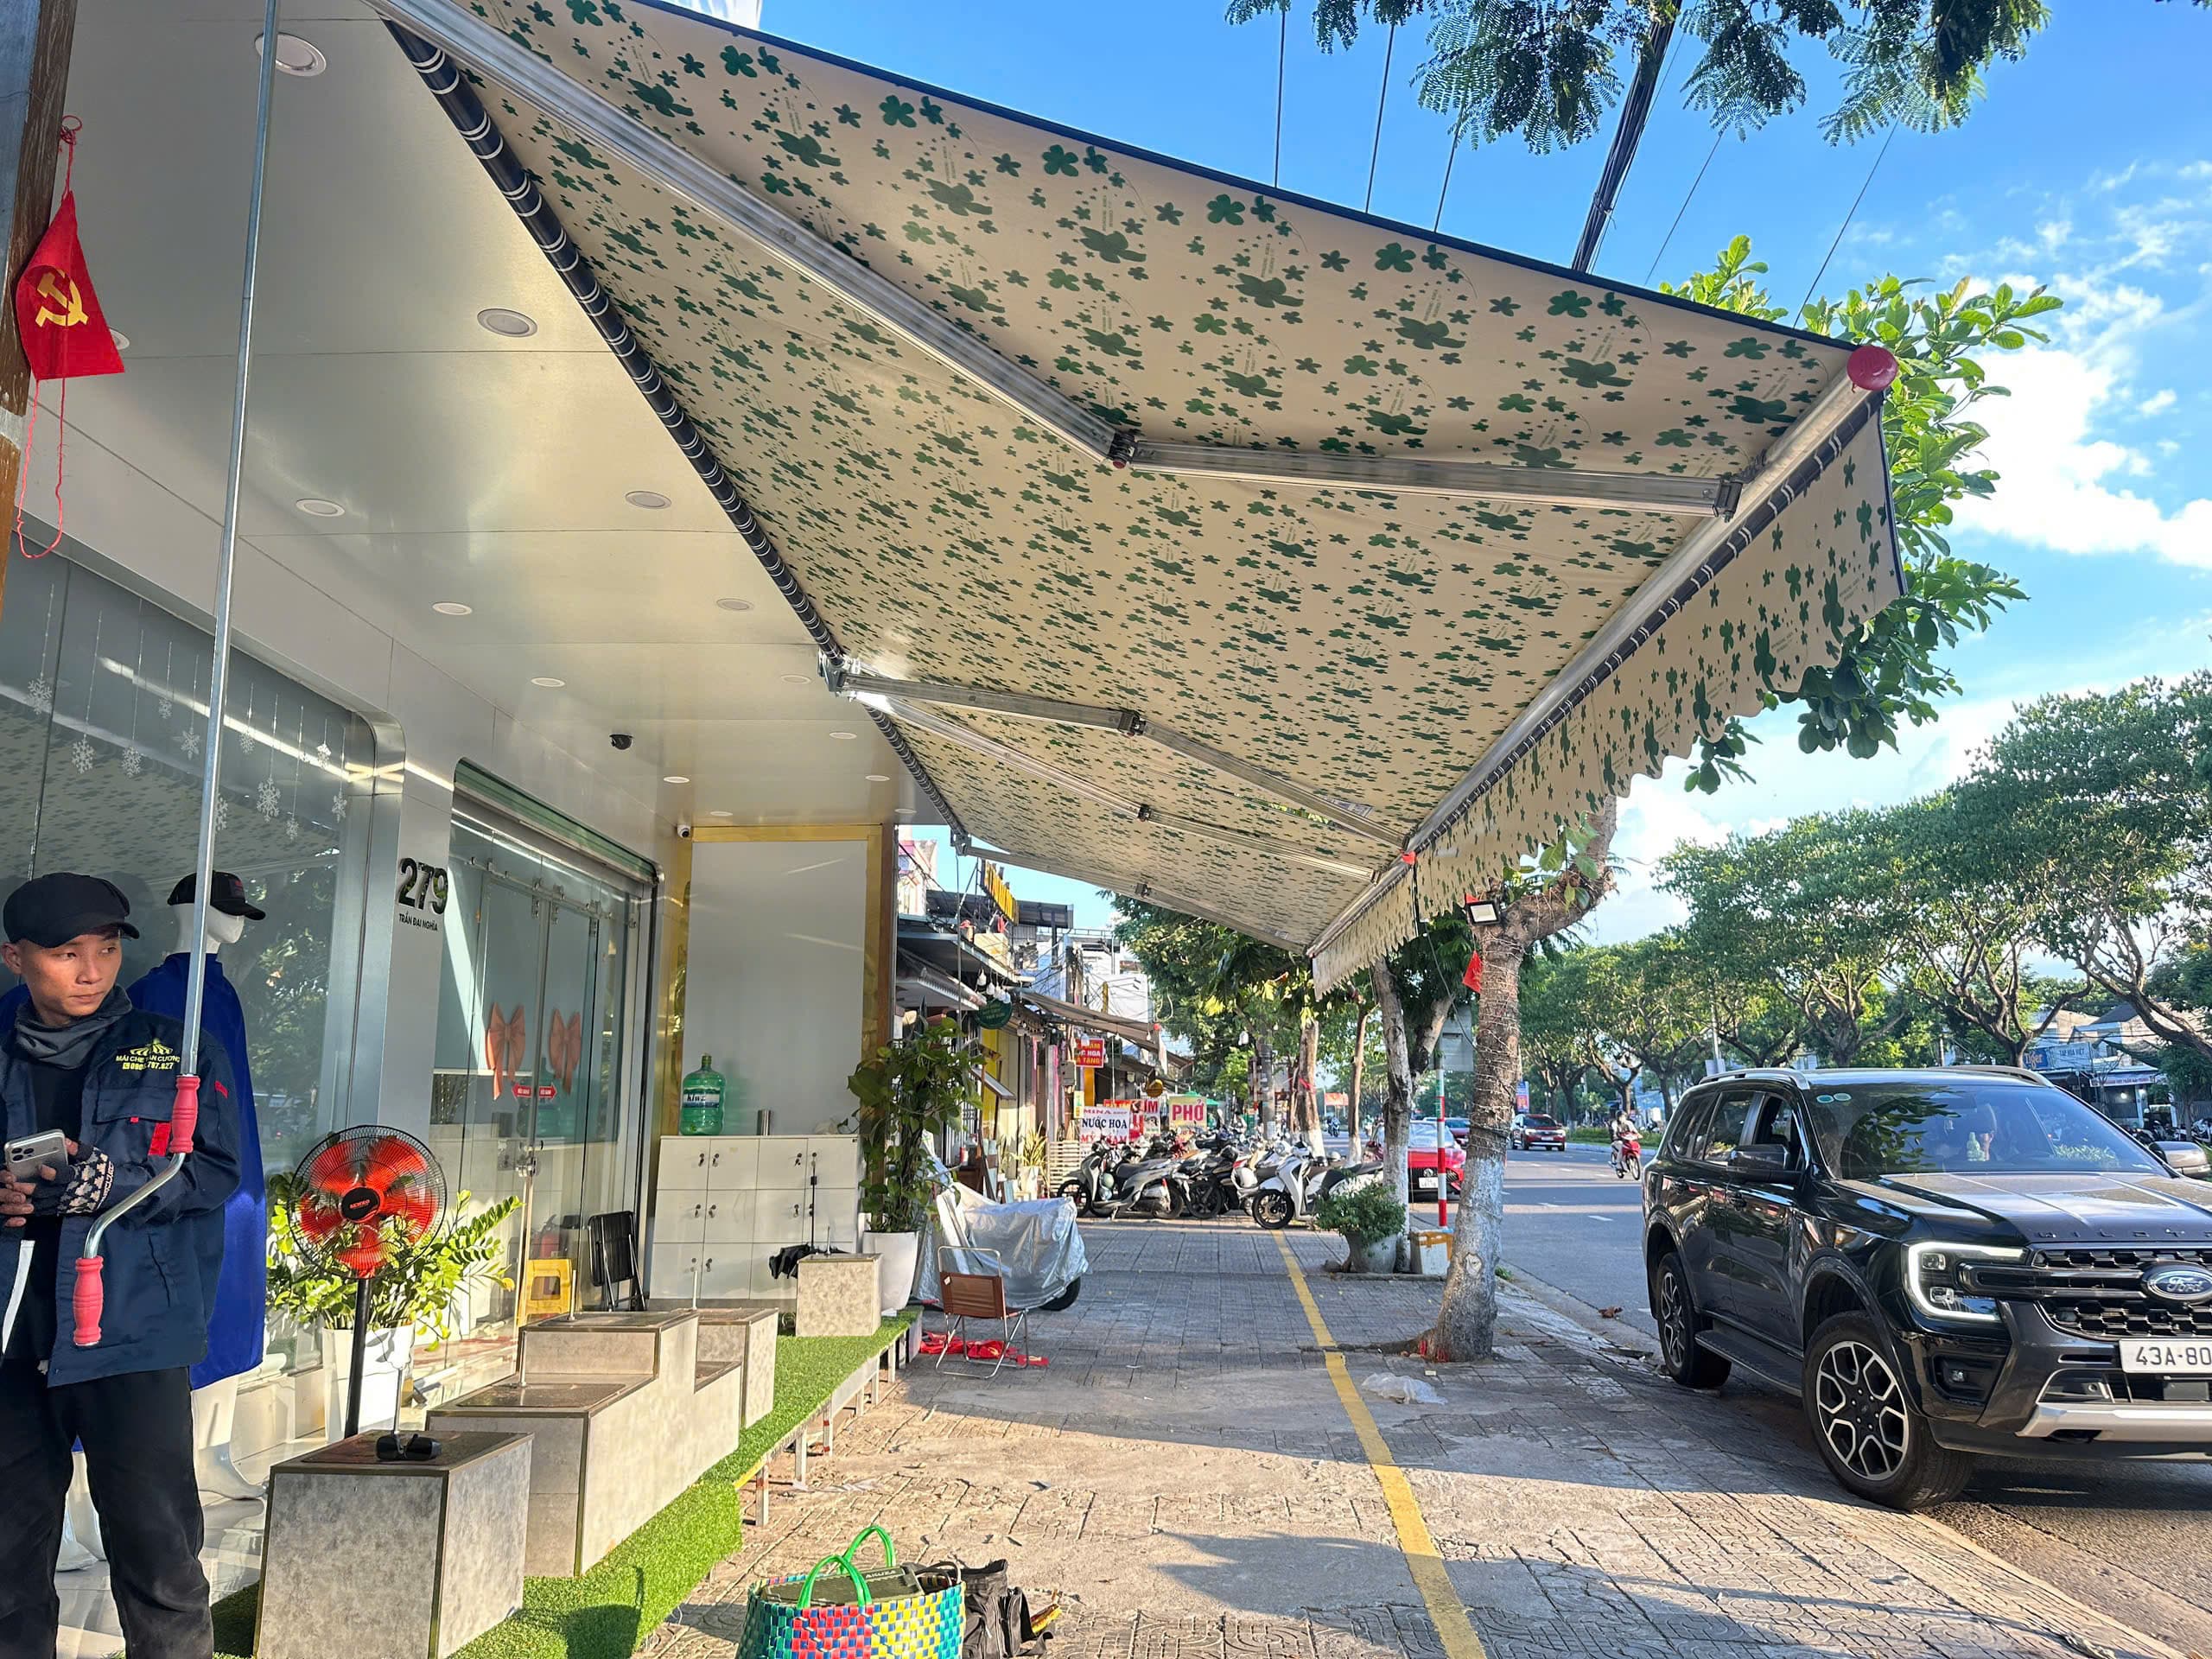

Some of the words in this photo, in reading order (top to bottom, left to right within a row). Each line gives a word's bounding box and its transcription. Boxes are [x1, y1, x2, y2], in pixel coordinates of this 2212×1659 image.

[398, 858, 448, 915] 279
[1172, 1098, 1205, 1121] PHỞ
[1082, 1116, 1107, 1128] NƯỚC
[1109, 1119, 1128, 1129] HOA
[2165, 1275, 2203, 1294] Ford
[2135, 1346, 2212, 1366] 43A-80
